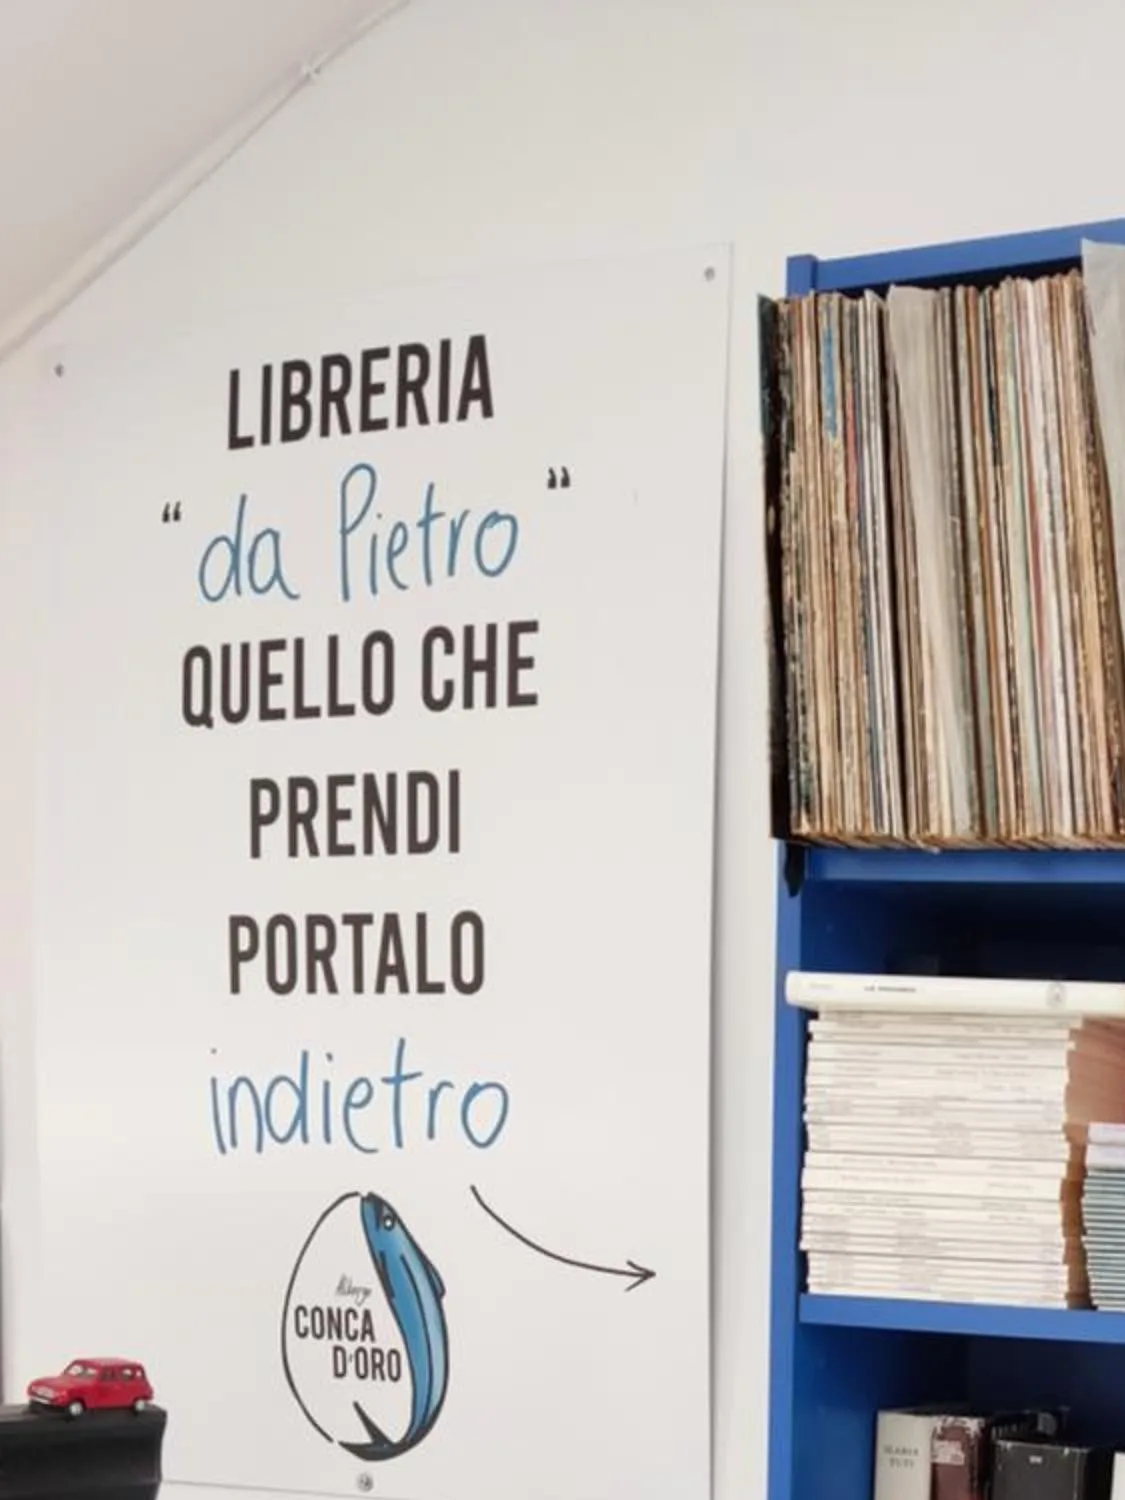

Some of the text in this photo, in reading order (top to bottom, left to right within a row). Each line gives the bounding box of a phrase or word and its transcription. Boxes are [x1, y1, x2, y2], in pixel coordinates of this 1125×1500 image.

[228, 334, 494, 450] LIBRERIA
[182, 620, 539, 729] QUELLO CHE
[250, 769, 460, 859] PRENDI
[229, 911, 484, 995] PORTALO
[211, 1037, 509, 1155] indietro
[294, 1305, 401, 1382] CONCA D'ORO
